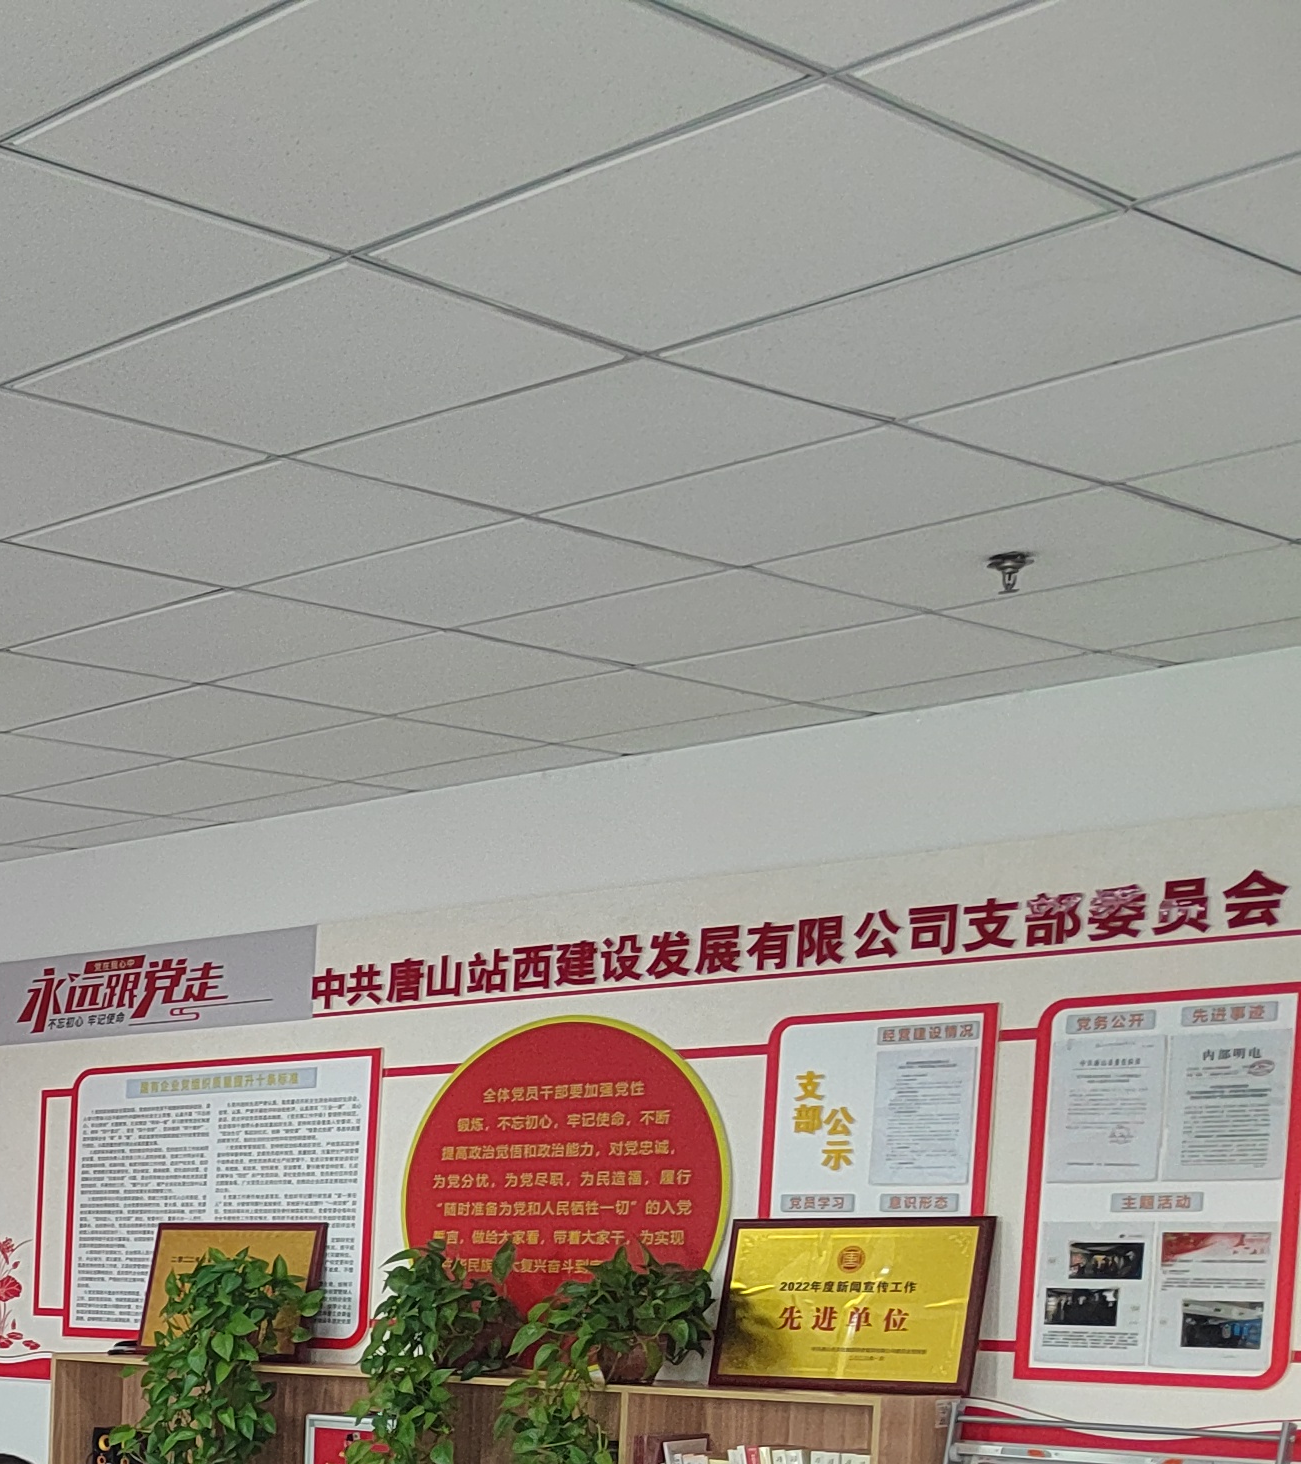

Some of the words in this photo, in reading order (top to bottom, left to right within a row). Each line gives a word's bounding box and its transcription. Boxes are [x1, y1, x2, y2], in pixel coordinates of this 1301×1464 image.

[311, 869, 1289, 1010] 中共唐山站西建设发展有限公司支部委员会
[17, 957, 229, 1034] 永远跟党走
[47, 1015, 84, 1030] 不忘初心
[87, 1012, 125, 1026] 牢记使命
[1076, 1012, 1145, 1032] 党务公开
[1192, 1004, 1266, 1024] 先进事迹
[882, 1023, 974, 1042] 经营建设情况
[483, 1080, 645, 1103] 全体党员干部要加强党性
[457, 1109, 672, 1133] 锻炼，不忘初心，牢记使命，不断
[433, 1169, 692, 1190] 为党分忧，为党尽职，为民造福，履行
[789, 1195, 845, 1210] 党员学习
[887, 1195, 949, 1210] 意识形态
[1121, 1194, 1192, 1210] 主题活动
[779, 1280, 918, 1294] 2022年度新闻宣传工作
[777, 1305, 910, 1333] 先进单位
